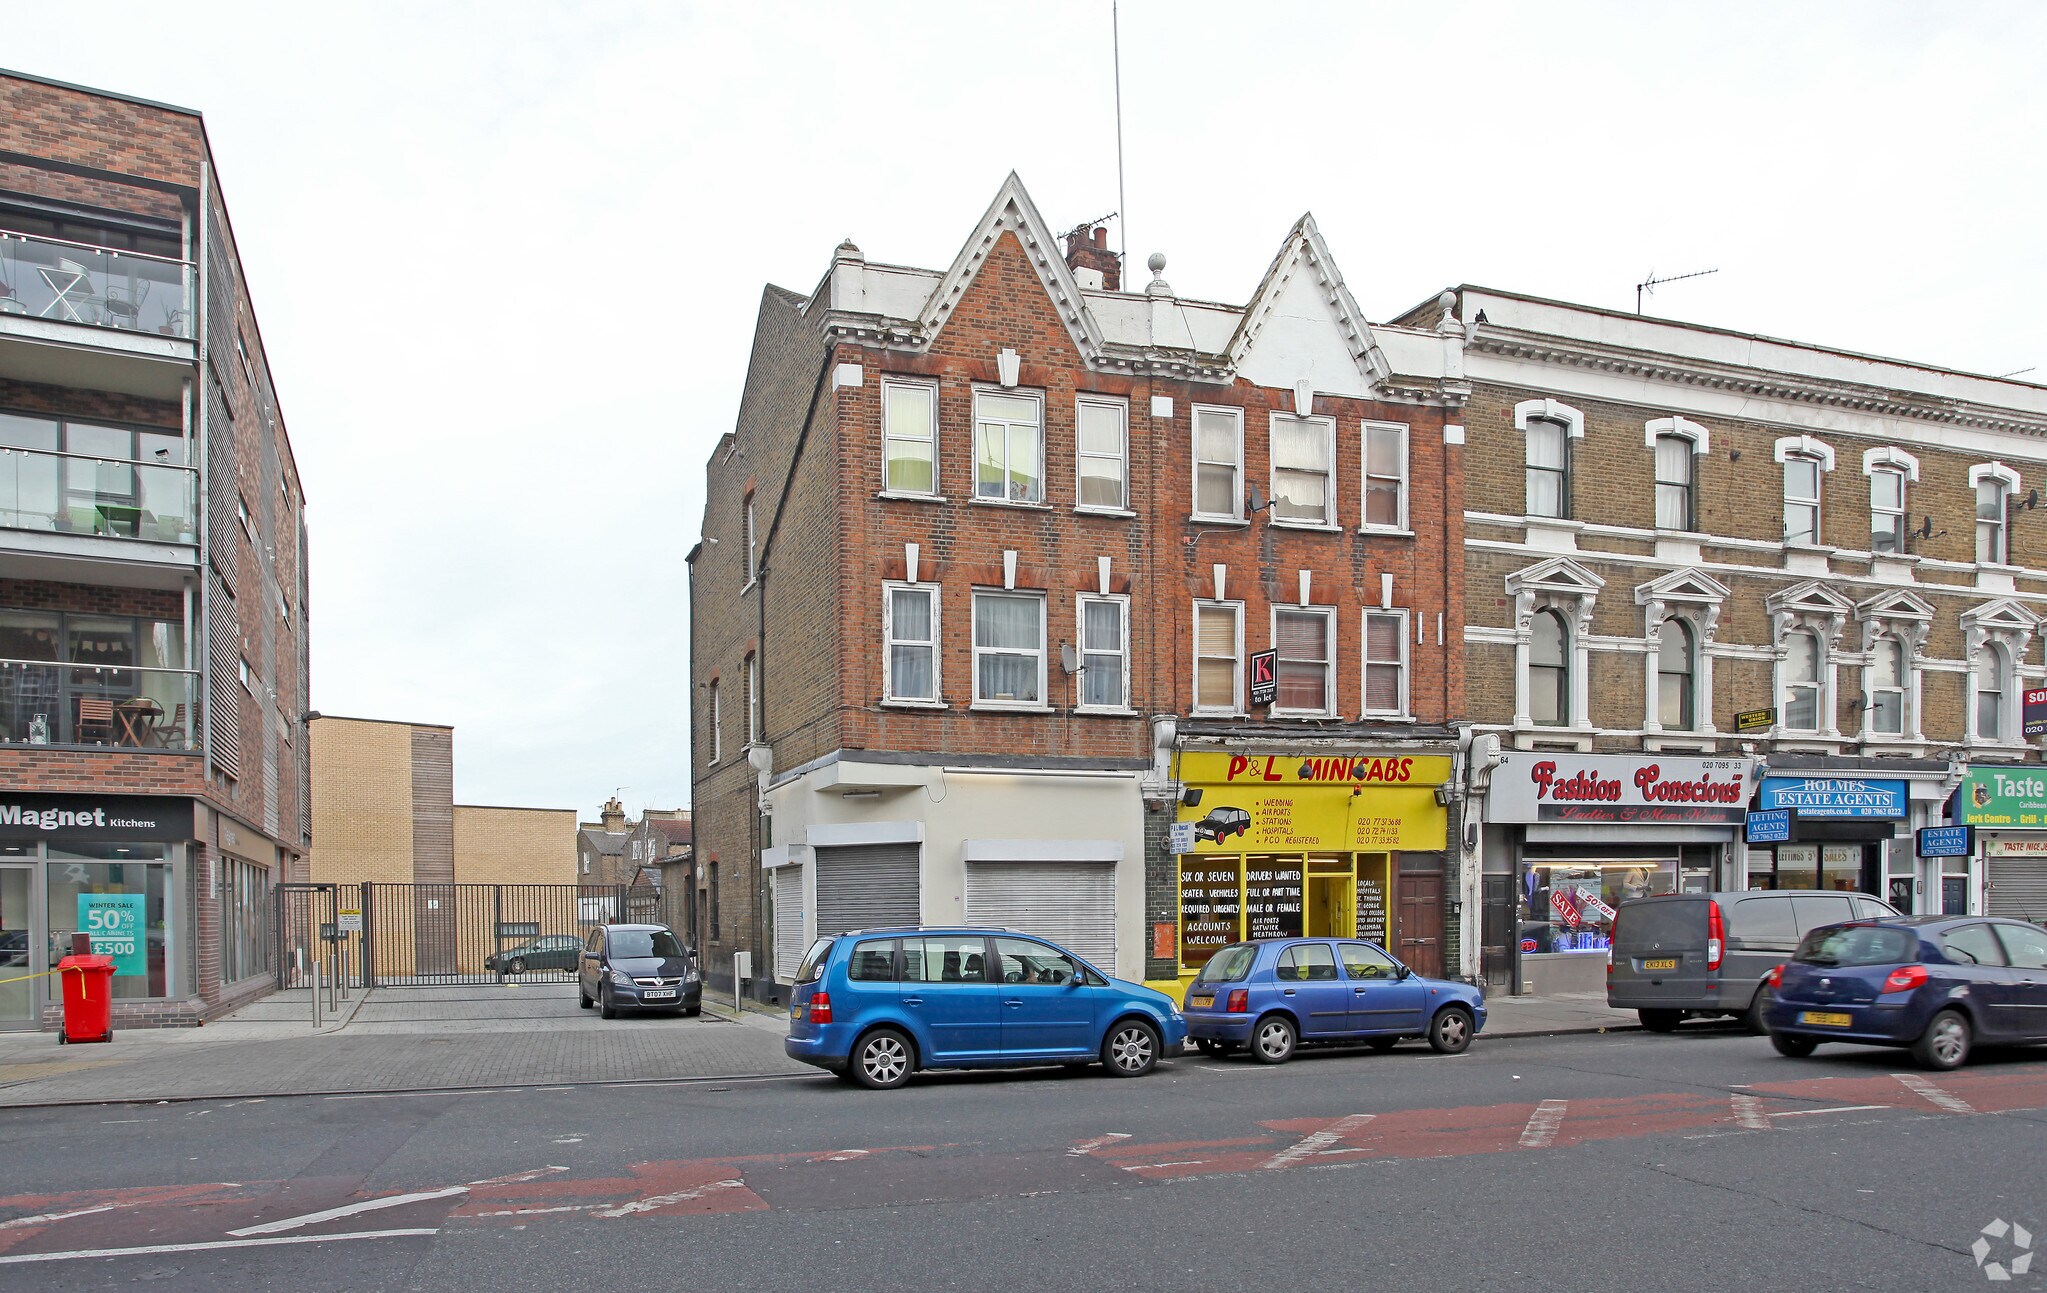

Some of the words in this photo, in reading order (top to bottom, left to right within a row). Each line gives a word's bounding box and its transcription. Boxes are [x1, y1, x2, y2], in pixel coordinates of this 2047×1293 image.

[1255, 655, 1273, 682] K
[1263, 693, 1272, 702] let
[2028, 691, 2047, 703] SO
[2025, 725, 2043, 733] 020
[1298, 757, 1414, 782] MINICABS
[1531, 761, 1622, 802] Fashion
[1634, 764, 1741, 803] Conscious
[1804, 780, 1865, 792] HOLMES
[1994, 774, 2044, 798] Taste
[1263, 799, 1294, 807] WEDDING
[1778, 793, 1832, 805] ESTATE
[1833, 793, 1890, 806] AGENTS
[2019, 801, 2047, 809] Caribbean
[1558, 805, 1615, 820] Ladies
[1620, 808, 1638, 820] &
[1750, 812, 1787, 822] LETTING
[1873, 808, 1887, 816] 7062
[1888, 808, 1901, 816] 0222
[0, 805, 105, 830] Magnet
[110, 818, 156, 828] Kitchens
[1261, 818, 1292, 826] STATIONS
[1357, 817, 1371, 826] 020
[1967, 814, 1983, 823] Jerk
[1984, 814, 2011, 823] Centre
[2020, 815, 2037, 824] Grill
[1262, 827, 1294, 835] HOSPITALS
[1357, 827, 1370, 835] 020
[1752, 822, 1785, 831] AGENTS
[1928, 830, 1962, 838] ESTATE
[1284, 837, 1320, 845] REGISTERED
[1356, 836, 1370, 844] 020
[1926, 838, 1963, 847] AGENTS
[2004, 843, 2024, 851] TASTE
[2026, 843, 2040, 851] NICE
[1778, 851, 1805, 860] LETTINGS
[1824, 849, 1847, 862] SALES
[1181, 872, 1193, 882] SIX
[1194, 872, 1204, 882] OR
[1207, 872, 1235, 882] SEVEN
[1246, 870, 1273, 881] DRIVERS
[1274, 870, 1301, 881] WANTED
[1181, 889, 1204, 898] SEATER
[1246, 888, 1261, 897] FULL
[1262, 888, 1270, 897] OR
[1272, 887, 1284, 896] PART
[1285, 887, 1301, 896] TIME
[1181, 904, 1210, 914] REQUIRED
[1212, 904, 1240, 914] URGENTLY
[1246, 903, 1264, 913] MALE
[1265, 903, 1273, 913] OR
[1276, 903, 1301, 912] FEMALE
[1552, 893, 1579, 925] SALE
[1600, 906, 1614, 918] OFF
[88, 909, 135, 930] 50%
[1186, 922, 1231, 932] ACCOUNTS
[1186, 935, 1227, 945] WELCOME
[94, 942, 135, 955] £500
[1520, 941, 1537, 951] PEN
